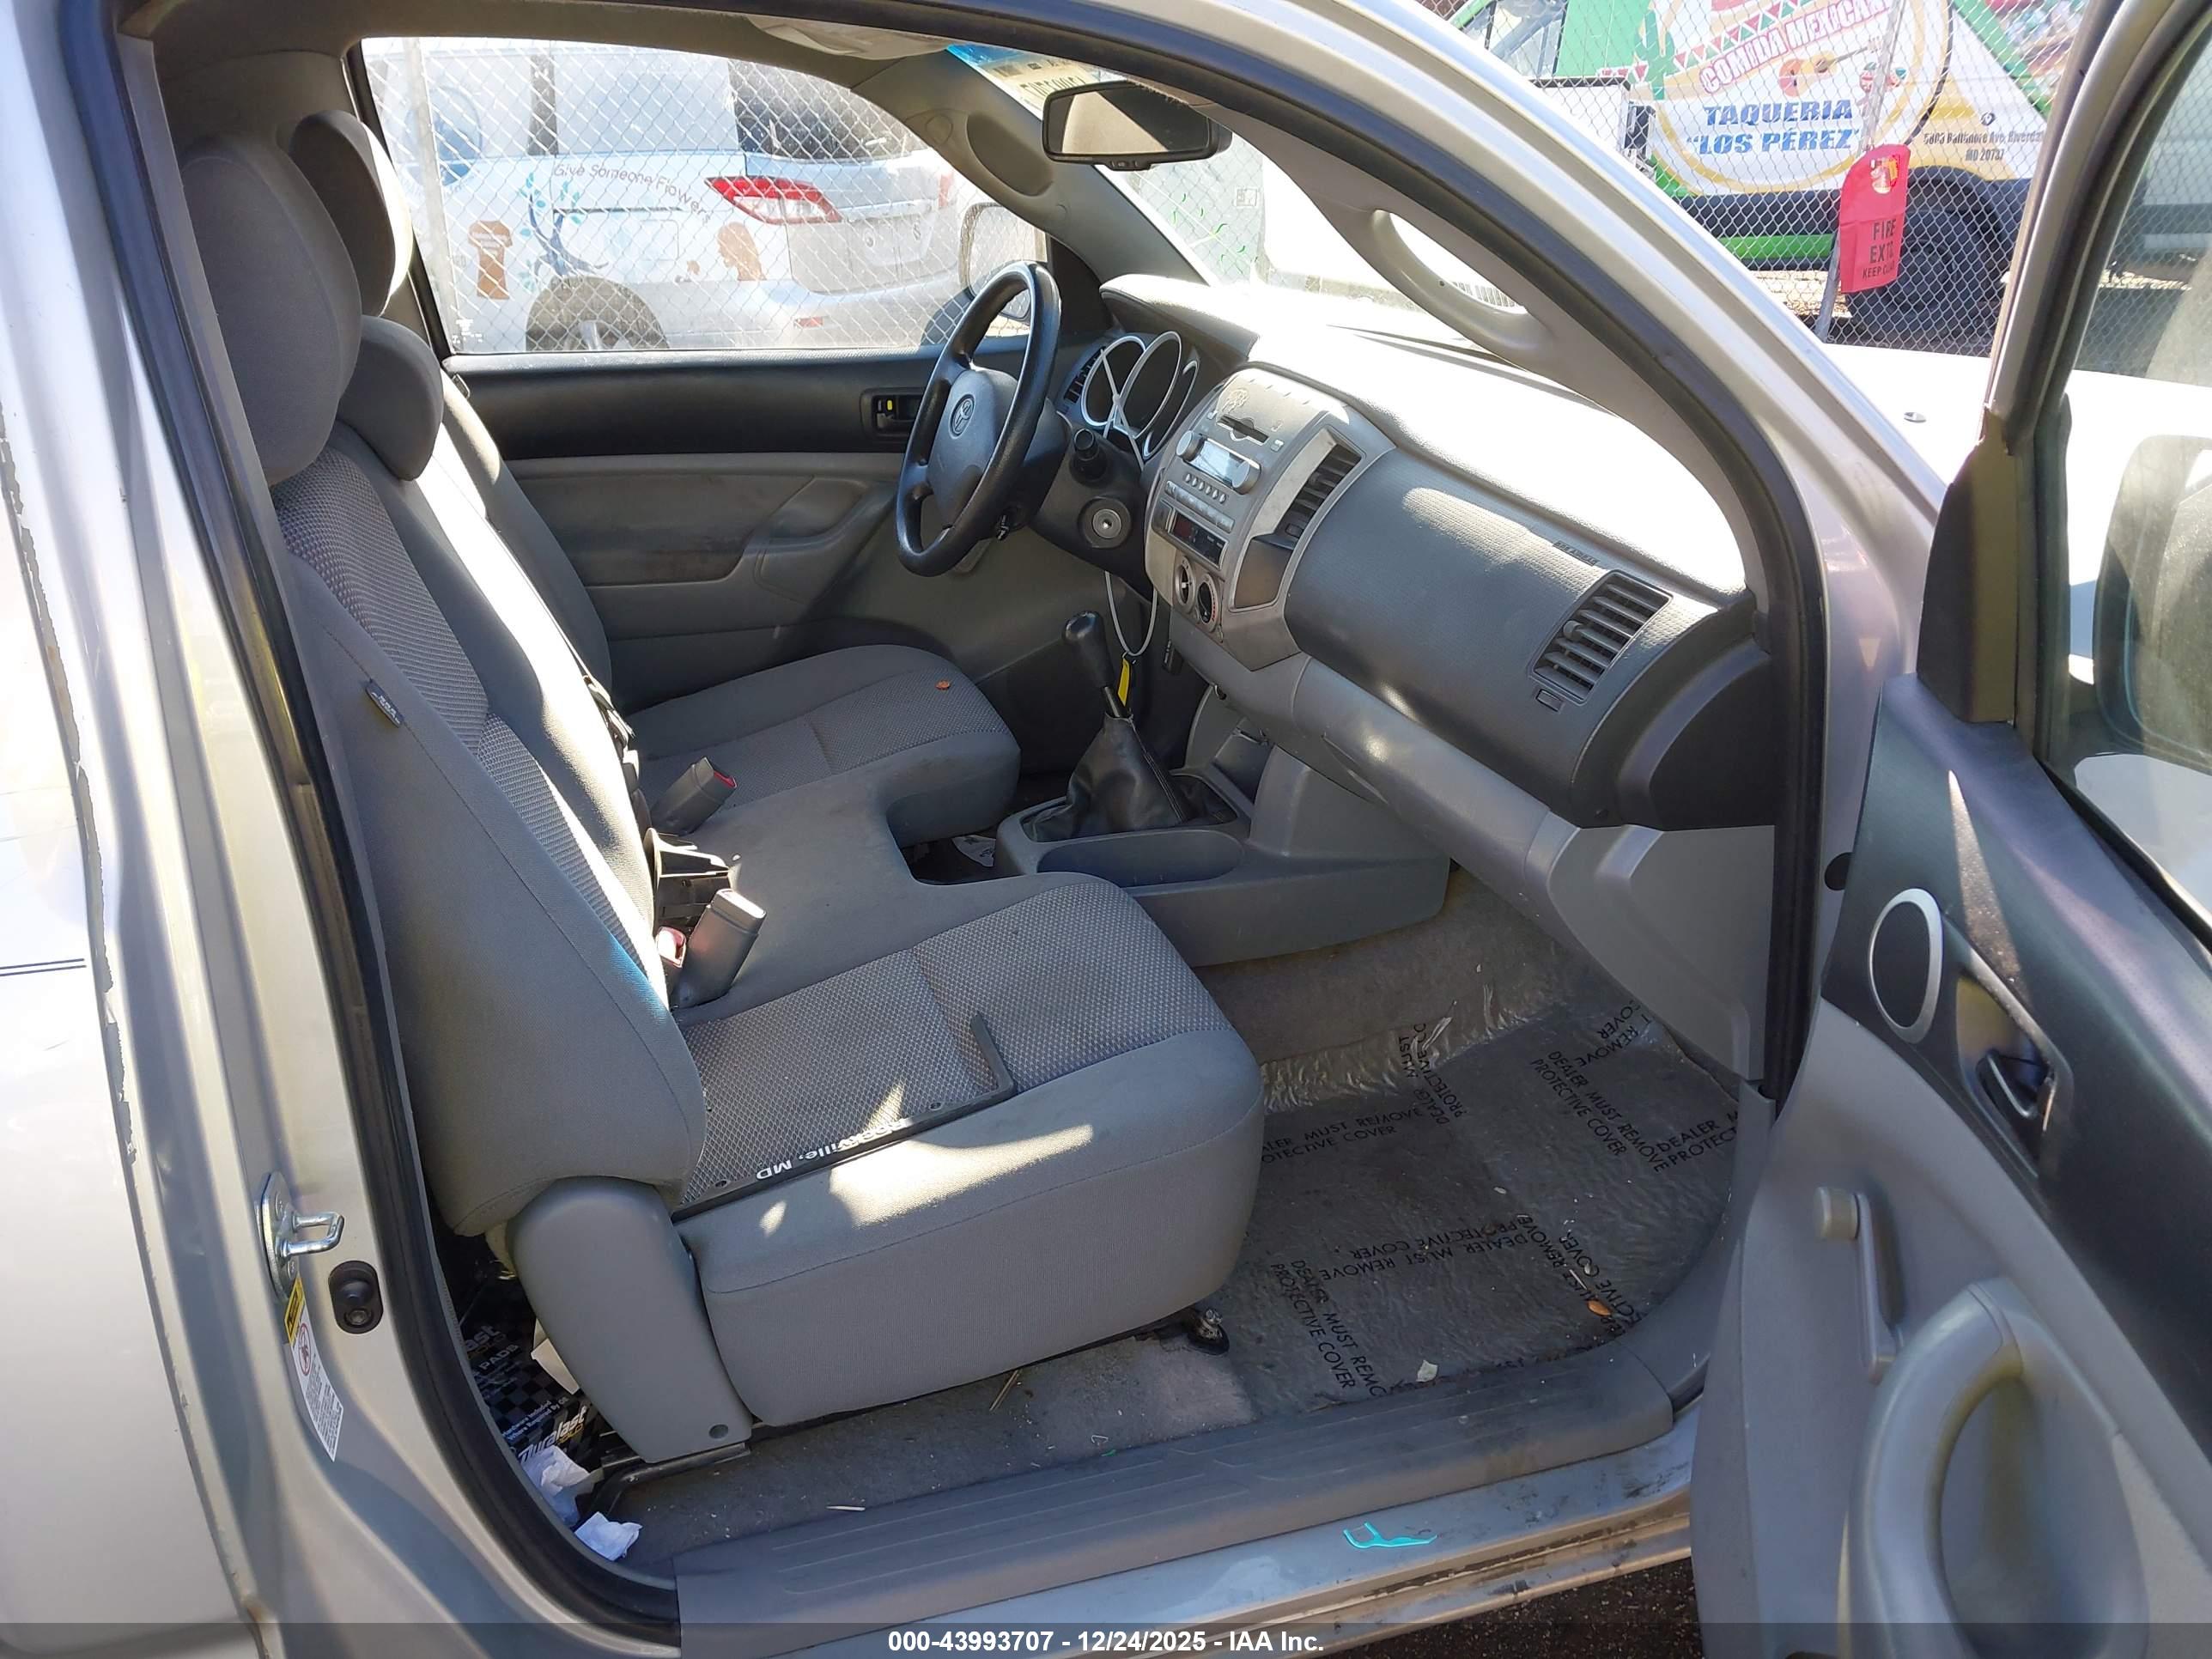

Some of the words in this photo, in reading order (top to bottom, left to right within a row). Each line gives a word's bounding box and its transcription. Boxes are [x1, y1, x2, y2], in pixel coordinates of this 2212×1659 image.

[1699, 28, 1789, 94] COMIDA
[1704, 100, 1852, 126] TAQUERIA
[1966, 149, 1978, 161] MD
[1979, 149, 2004, 161] 20737
[553, 163, 586, 177] Give
[589, 163, 653, 187] Someone
[1862, 265, 1881, 280] KEEP
[1398, 1036, 1419, 1079] MUST
[1530, 1059, 1592, 1117] PROTECTIVE
[1587, 1118, 1626, 1156] COVER
[1548, 1050, 1589, 1089] DEALER
[1586, 1091, 1622, 1121] MUST
[1617, 1123, 1669, 1173] REMOVE
[1304, 1121, 1347, 1141] MUST
[1356, 1106, 1424, 1128] REMOVE
[1343, 1125, 1396, 1143] COVER
[1656, 1120, 1721, 1152] DEALER
[757, 1160, 793, 1181] MD
[1416, 1221, 1517, 1248] PRTECTIVE
[1351, 1240, 1410, 1260] COVER
[1406, 1247, 1453, 1265] MUST
[1319, 1257, 1396, 1280] REMOVE
[1322, 1313, 1358, 1348] MUST
[1318, 1342, 1356, 1389] COVER
